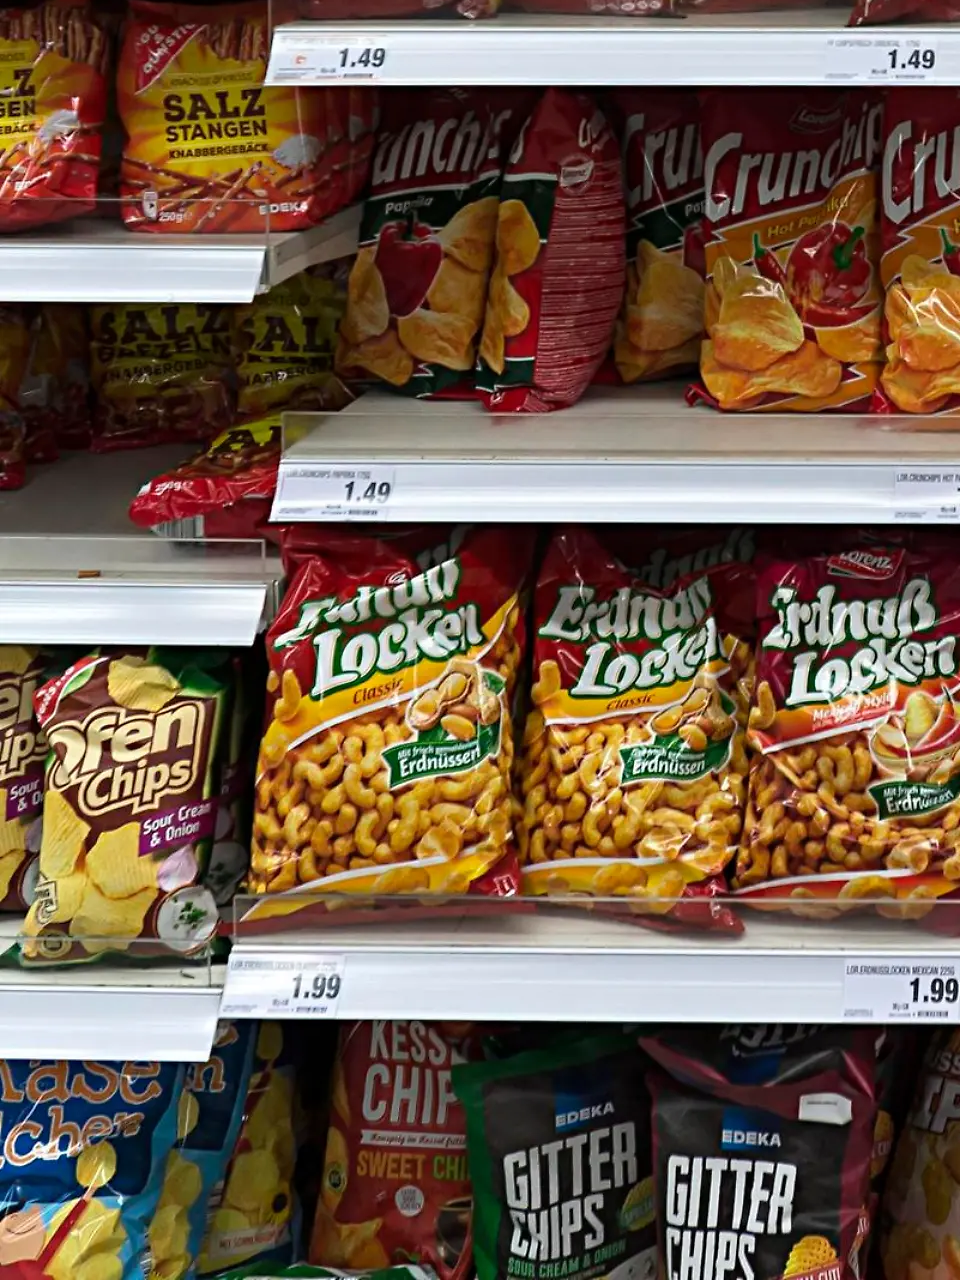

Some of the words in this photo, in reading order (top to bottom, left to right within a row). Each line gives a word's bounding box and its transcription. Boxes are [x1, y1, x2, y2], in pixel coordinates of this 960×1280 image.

[338, 47, 387, 68] 1.49
[887, 49, 936, 70] 1.49
[163, 88, 266, 122] SALZ
[166, 119, 268, 144] STANGEN
[168, 140, 269, 160] KNABBERGEBÄCK
[767, 222, 795, 239] Hot
[344, 481, 392, 504] 1.49
[840, 550, 894, 570] Lorenz
[762, 579, 938, 649] Erdnuß
[309, 603, 483, 701] Locken
[570, 617, 722, 696] Locken
[786, 635, 957, 708] Locken
[353, 676, 404, 706] Classic
[606, 693, 656, 711] Classic
[399, 746, 481, 777] Erdnüssen
[632, 757, 706, 776] Erdnüssen
[10, 778, 40, 800] Sour
[87, 757, 193, 806] Chips
[143, 813, 173, 834] Sour
[177, 802, 211, 823] Cream
[150, 833, 161, 848] &
[165, 820, 200, 841] Onion
[291, 973, 341, 1001] 1.99
[908, 977, 959, 1004] 1.99
[555, 1101, 615, 1127] EDEKA
[722, 1128, 781, 1147] EDEKA
[356, 1149, 424, 1179] SWEET
[503, 1121, 637, 1210] GITTER
[666, 1154, 798, 1235] GITTER
[509, 1193, 604, 1261] CHIPS
[507, 1255, 535, 1276] SOUR
[538, 1249, 579, 1276] CREAM
[593, 1240, 626, 1263] ONION
[665, 1228, 756, 1280] CHIPS
